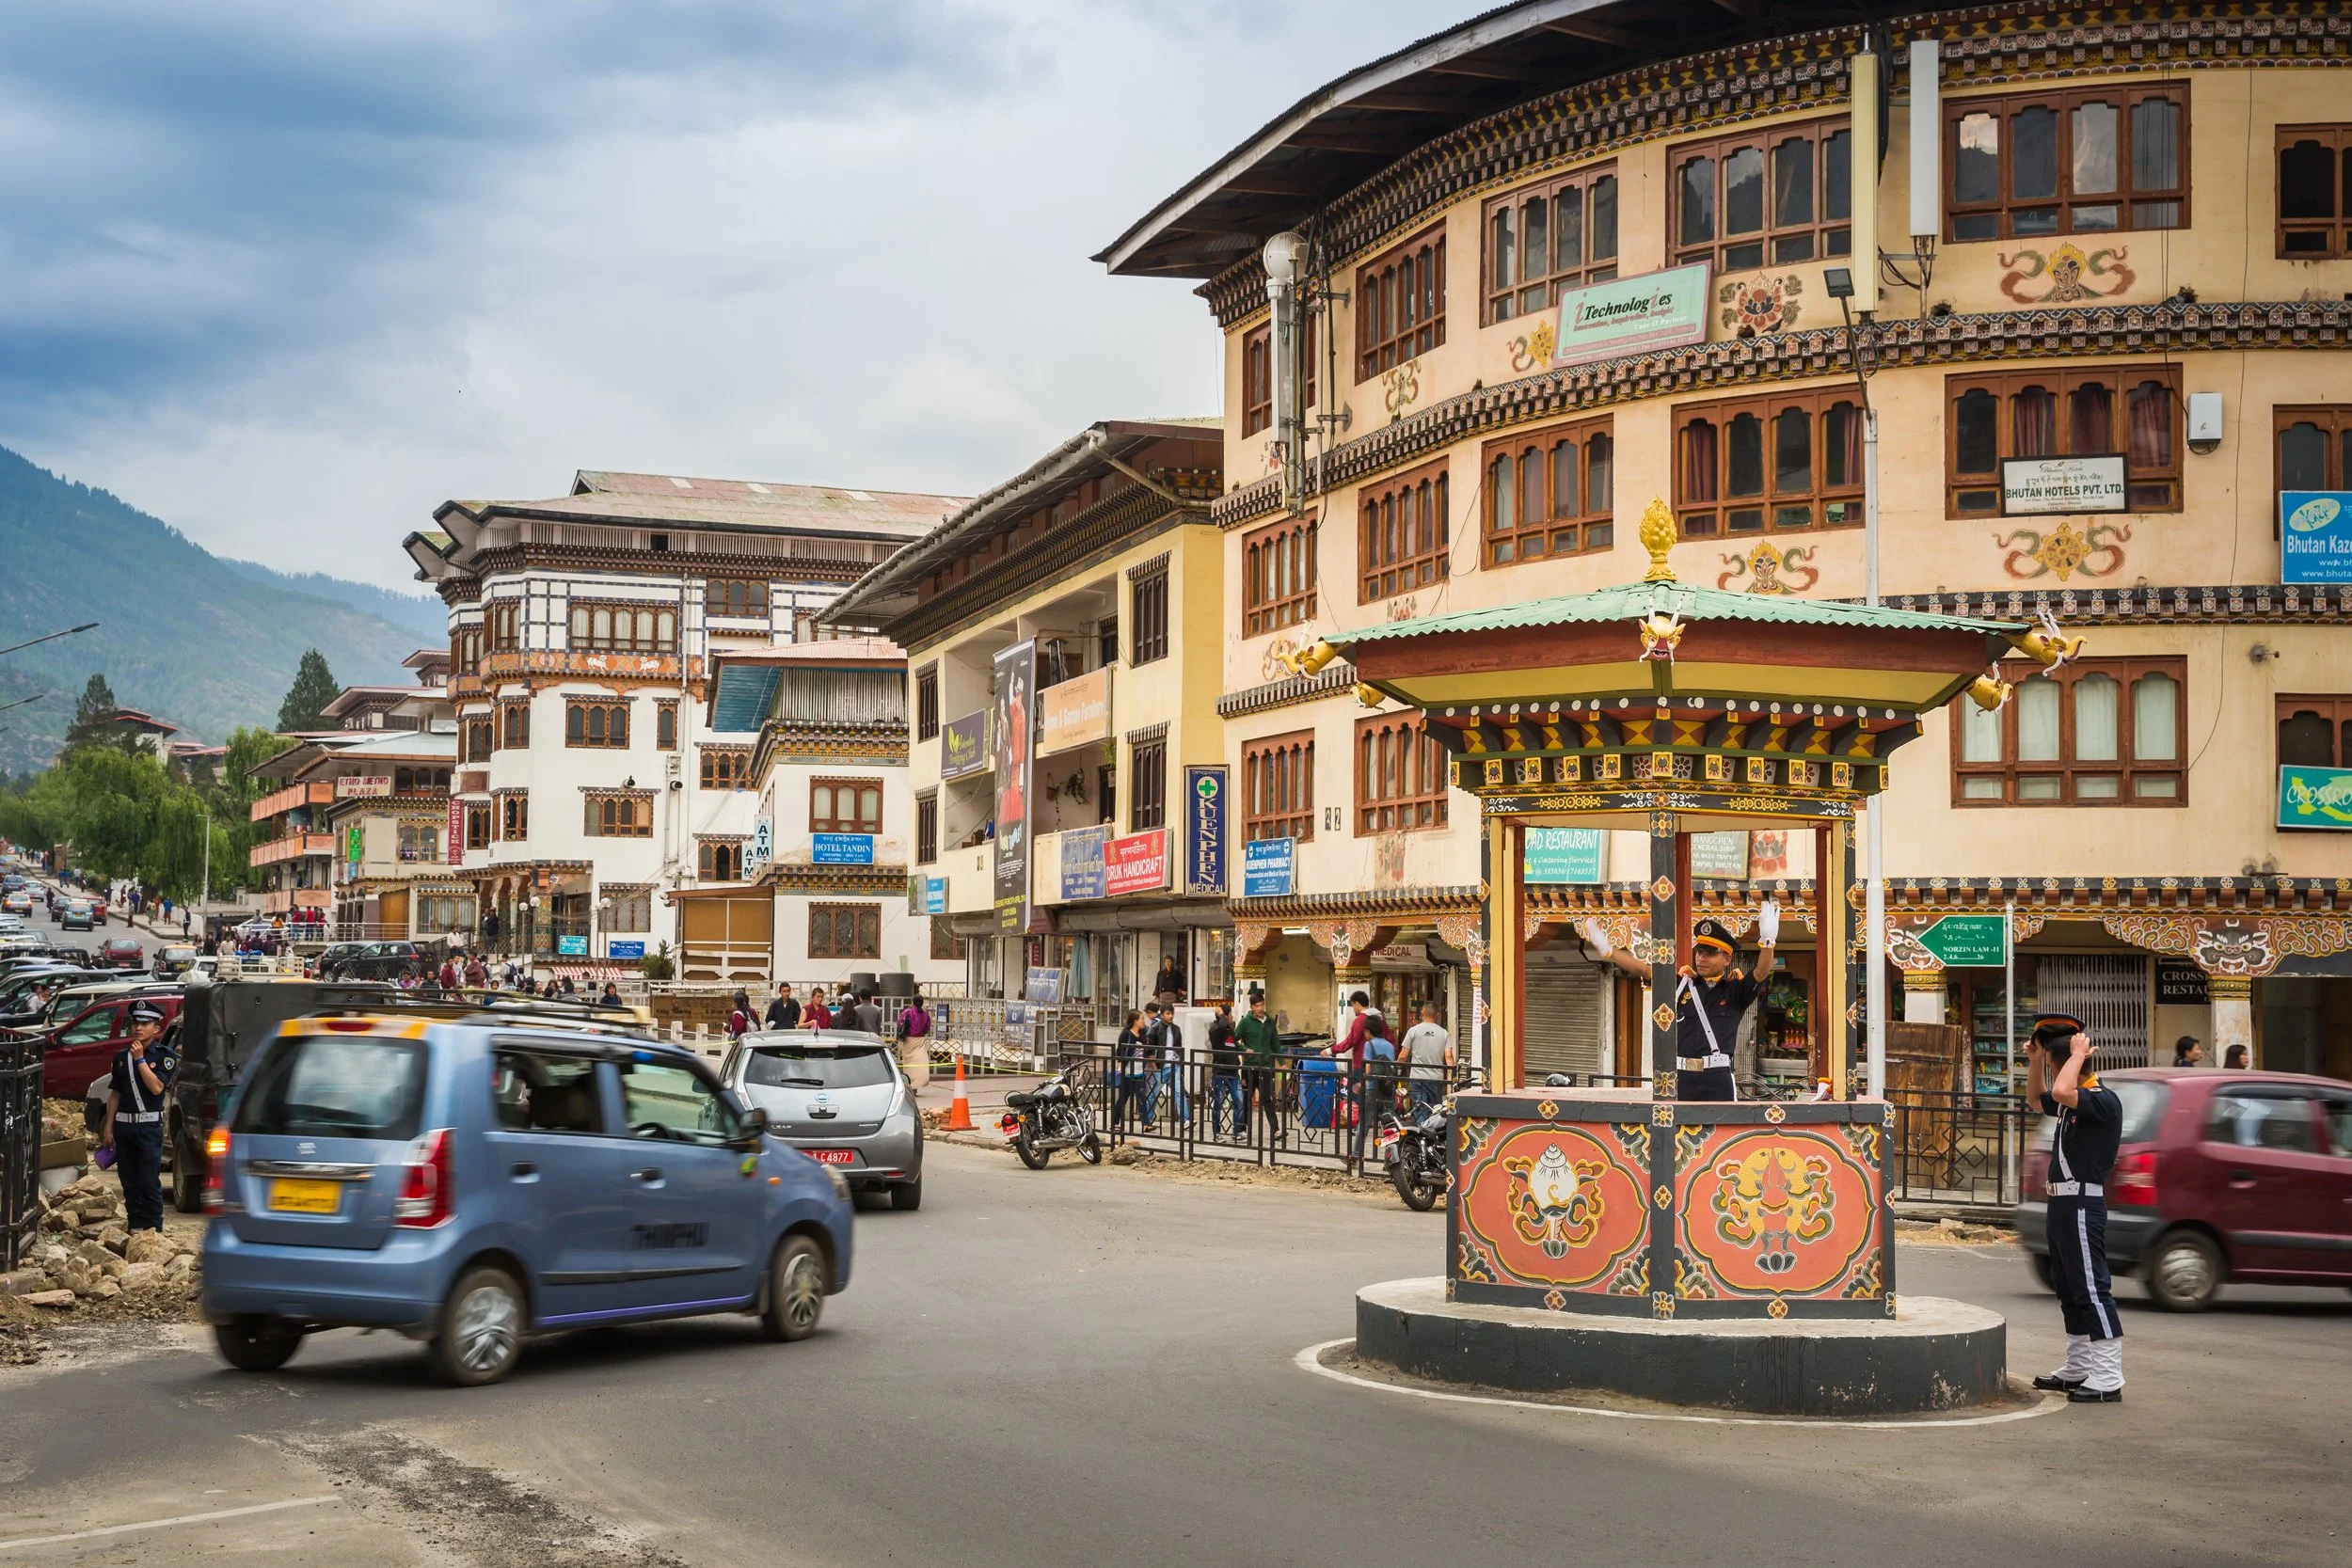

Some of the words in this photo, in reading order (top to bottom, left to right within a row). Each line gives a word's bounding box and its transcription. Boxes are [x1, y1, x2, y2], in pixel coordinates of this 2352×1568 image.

[1661, 315, 1687, 325] Partner
[2006, 487, 2042, 499] BHUTAN
[2044, 485, 2080, 497] HOTELS
[2083, 484, 2102, 495] PVT.
[2105, 483, 2124, 494] LTD.
[2287, 534, 2326, 553] Bhutan
[347, 787, 378, 796] PLAZA
[452, 800, 460, 845] CHOPSTICK
[756, 825, 770, 856] ATM
[1197, 798, 1217, 884] KUENPHEN
[1546, 830, 1598, 850] RESTAURANT
[815, 843, 841, 852] HOTEL
[841, 844, 871, 853] TANDIN
[1106, 863, 1122, 881] DRUK
[1122, 856, 1163, 879] HANDICRAFT
[1246, 859, 1266, 871] KUENPHEN
[1267, 857, 1291, 869] PHARMACY
[1538, 856, 1568, 867] Catering
[1189, 882, 1224, 895] MEDICAL
[2162, 971, 2208, 981] CROSS
[820, 1152, 849, 1163] C4877
